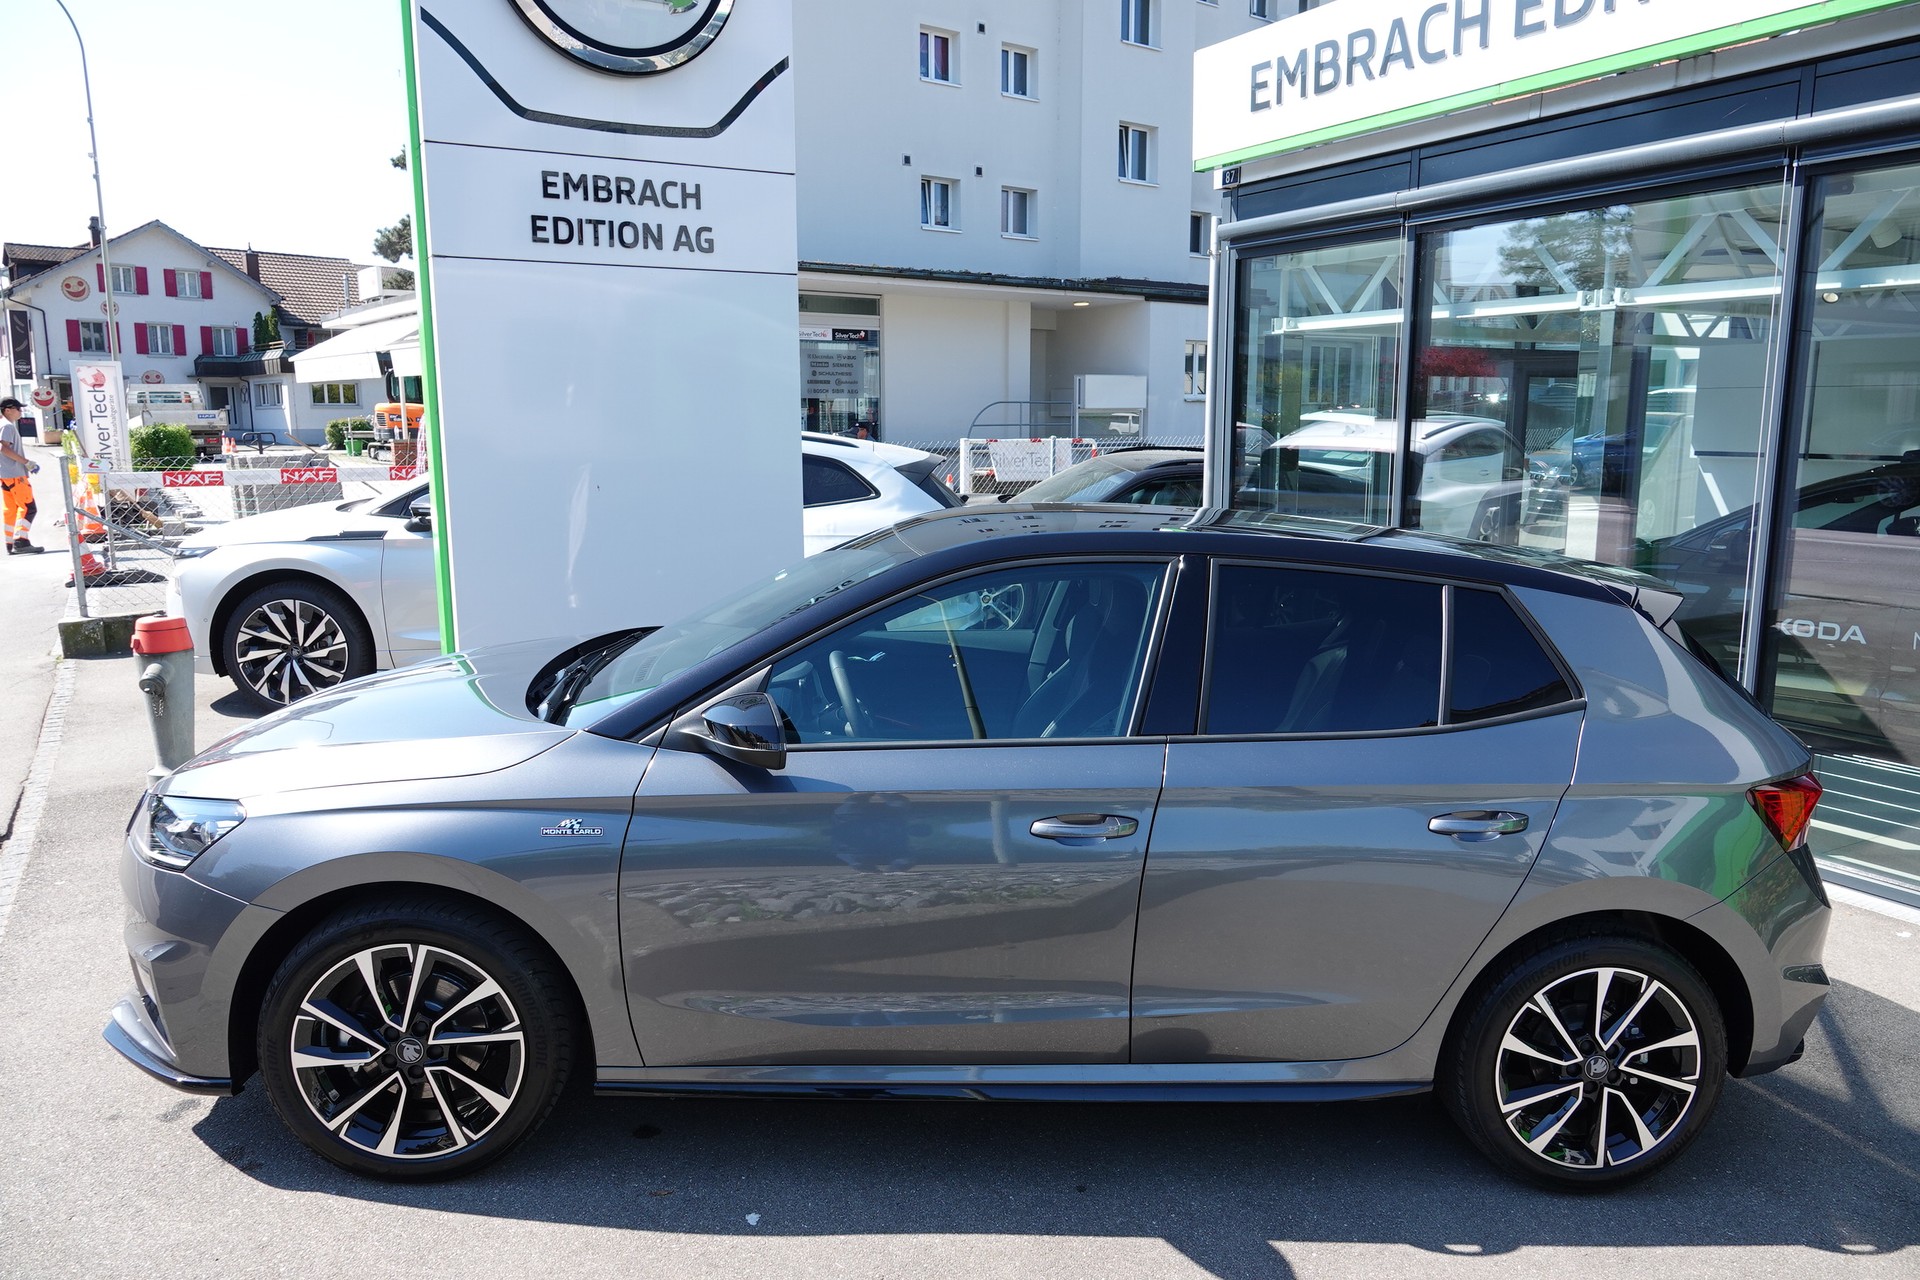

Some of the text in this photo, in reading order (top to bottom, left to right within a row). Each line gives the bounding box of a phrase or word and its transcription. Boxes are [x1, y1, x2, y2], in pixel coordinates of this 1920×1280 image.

[1250, 0, 1490, 113] EMBRACH
[541, 170, 702, 210] EMBRACH
[1225, 170, 1236, 184] 87
[530, 214, 715, 254] EDITION AG
